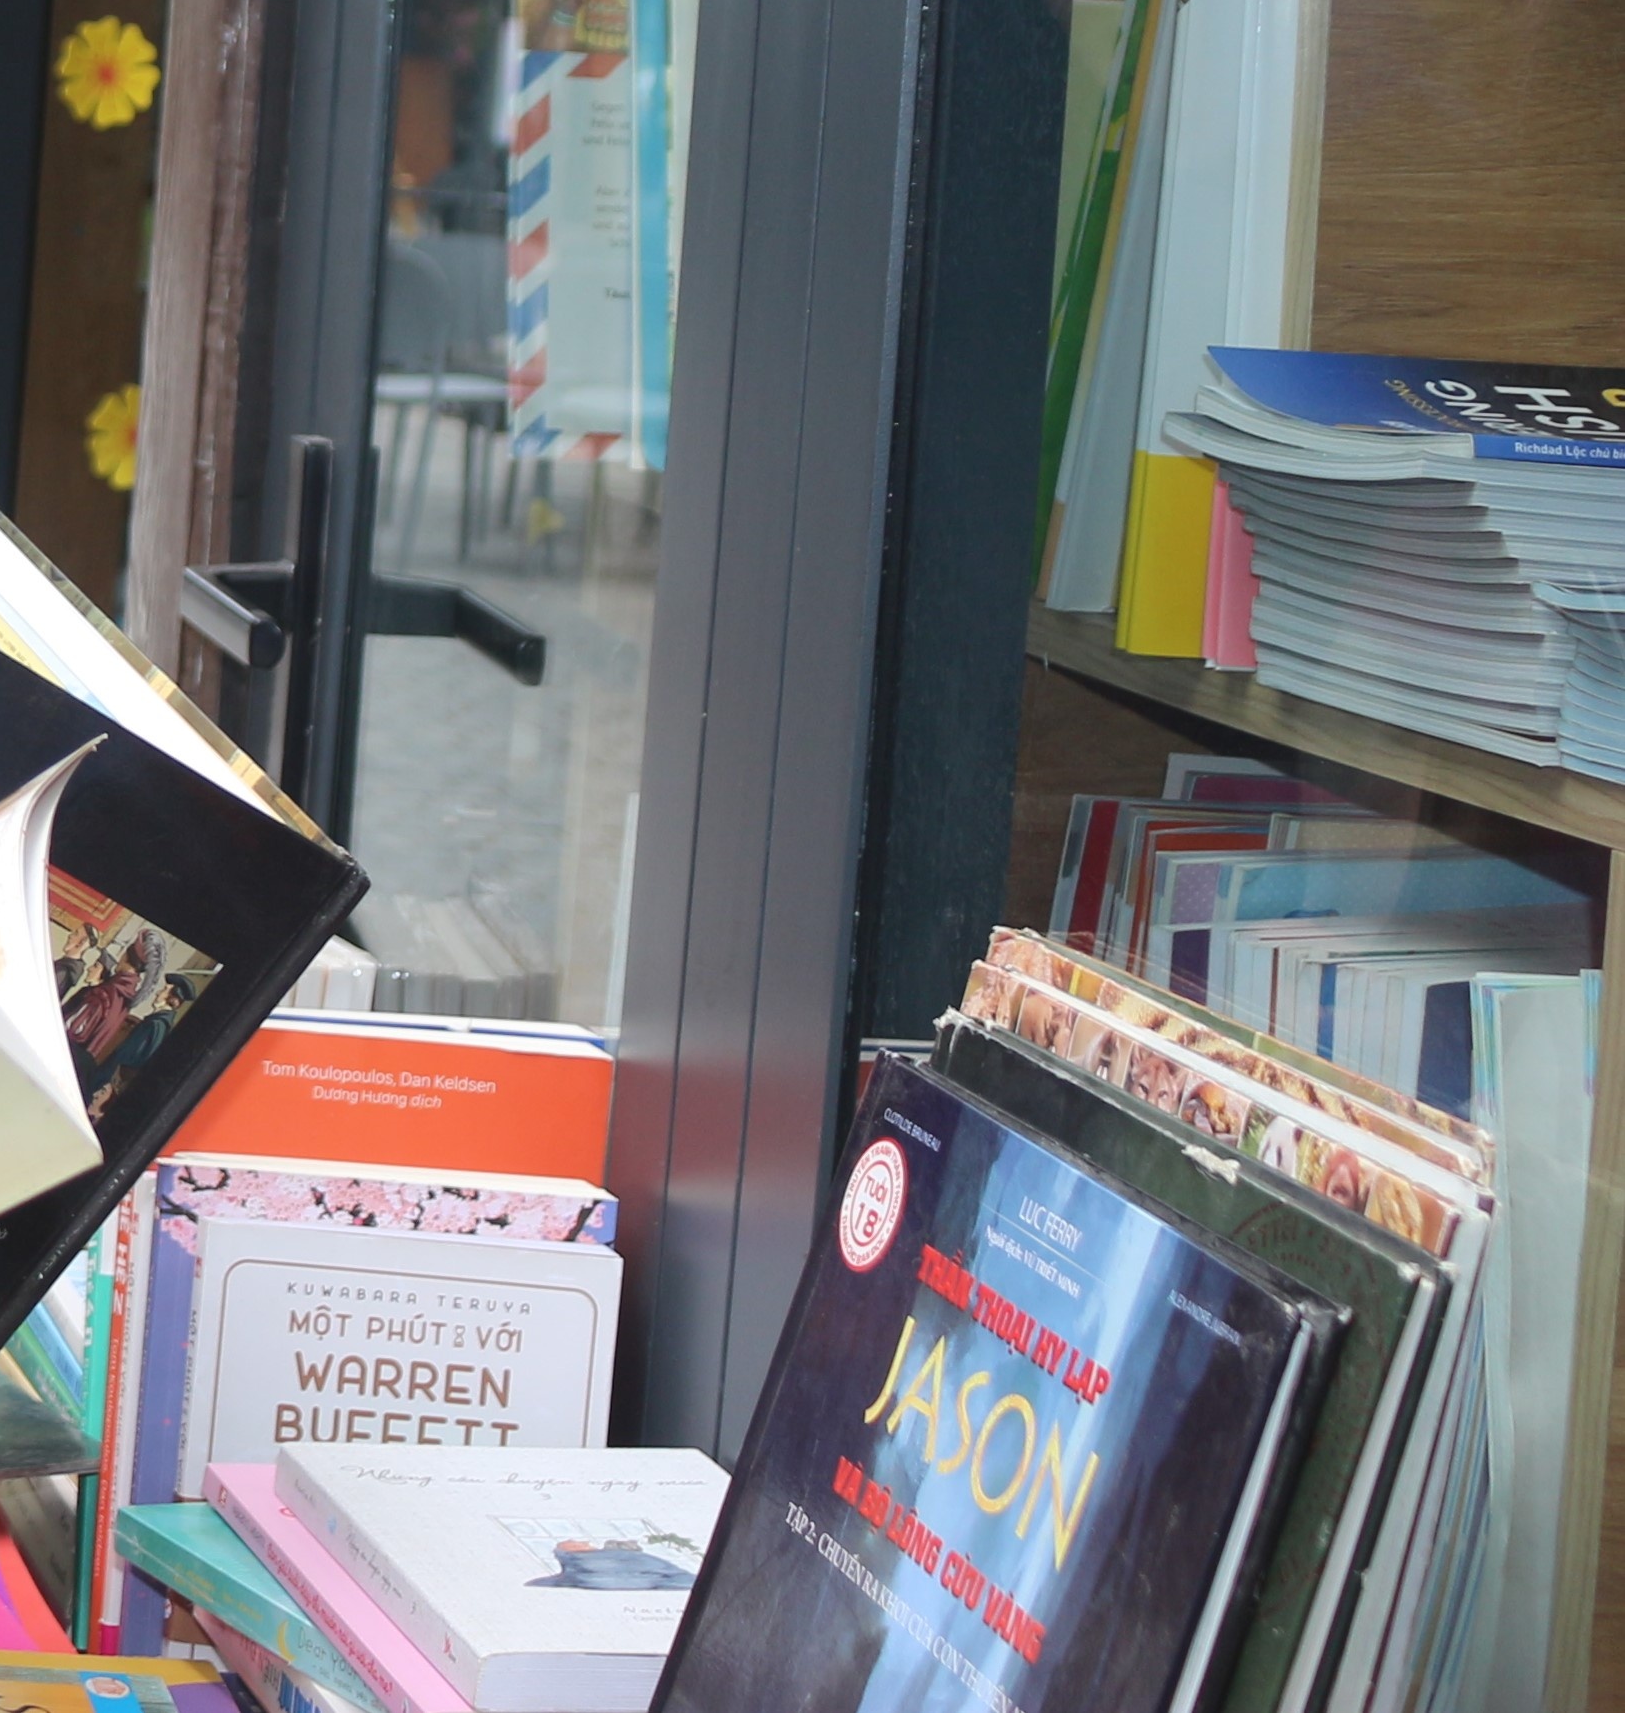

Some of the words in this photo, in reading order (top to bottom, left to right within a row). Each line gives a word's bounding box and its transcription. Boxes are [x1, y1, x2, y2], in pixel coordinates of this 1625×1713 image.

[1514, 442, 1562, 456] Richdad
[1565, 444, 1586, 460] Lộc
[1590, 446, 1610, 459] chủ
[261, 1060, 295, 1077] Tom
[298, 1064, 397, 1088] Koulopoulos,
[400, 1072, 431, 1088] Dan
[434, 1074, 497, 1094] Keldsen
[312, 1086, 359, 1105] Dương
[411, 1093, 442, 1110] dịch
[1018, 1195, 1045, 1229] LUC
[1042, 1210, 1083, 1253] FERRY
[286, 1281, 418, 1305] KUWABARA
[437, 1294, 531, 1315] TERUYA
[289, 1305, 353, 1342] MỘT
[366, 1313, 448, 1346] PHÚT
[476, 1321, 524, 1353] VỚI
[972, 1282, 1038, 1357] THOẠI
[1030, 1326, 1068, 1377] HY
[1062, 1347, 1112, 1406] LẠP
[295, 1350, 511, 1409] WARREN
[863, 1315, 1099, 1573] JASON
[785, 1501, 810, 1535] TẬP
[818, 1533, 866, 1587] CHUYẾN
[861, 1570, 881, 1604] RA
[931, 1636, 964, 1673] CON
[832, 1455, 864, 1507] VÀ
[858, 1478, 893, 1535] BỘ
[885, 1503, 944, 1577] LÔNG
[940, 1550, 989, 1611] CỪU
[982, 1584, 1047, 1666] VÀNG
